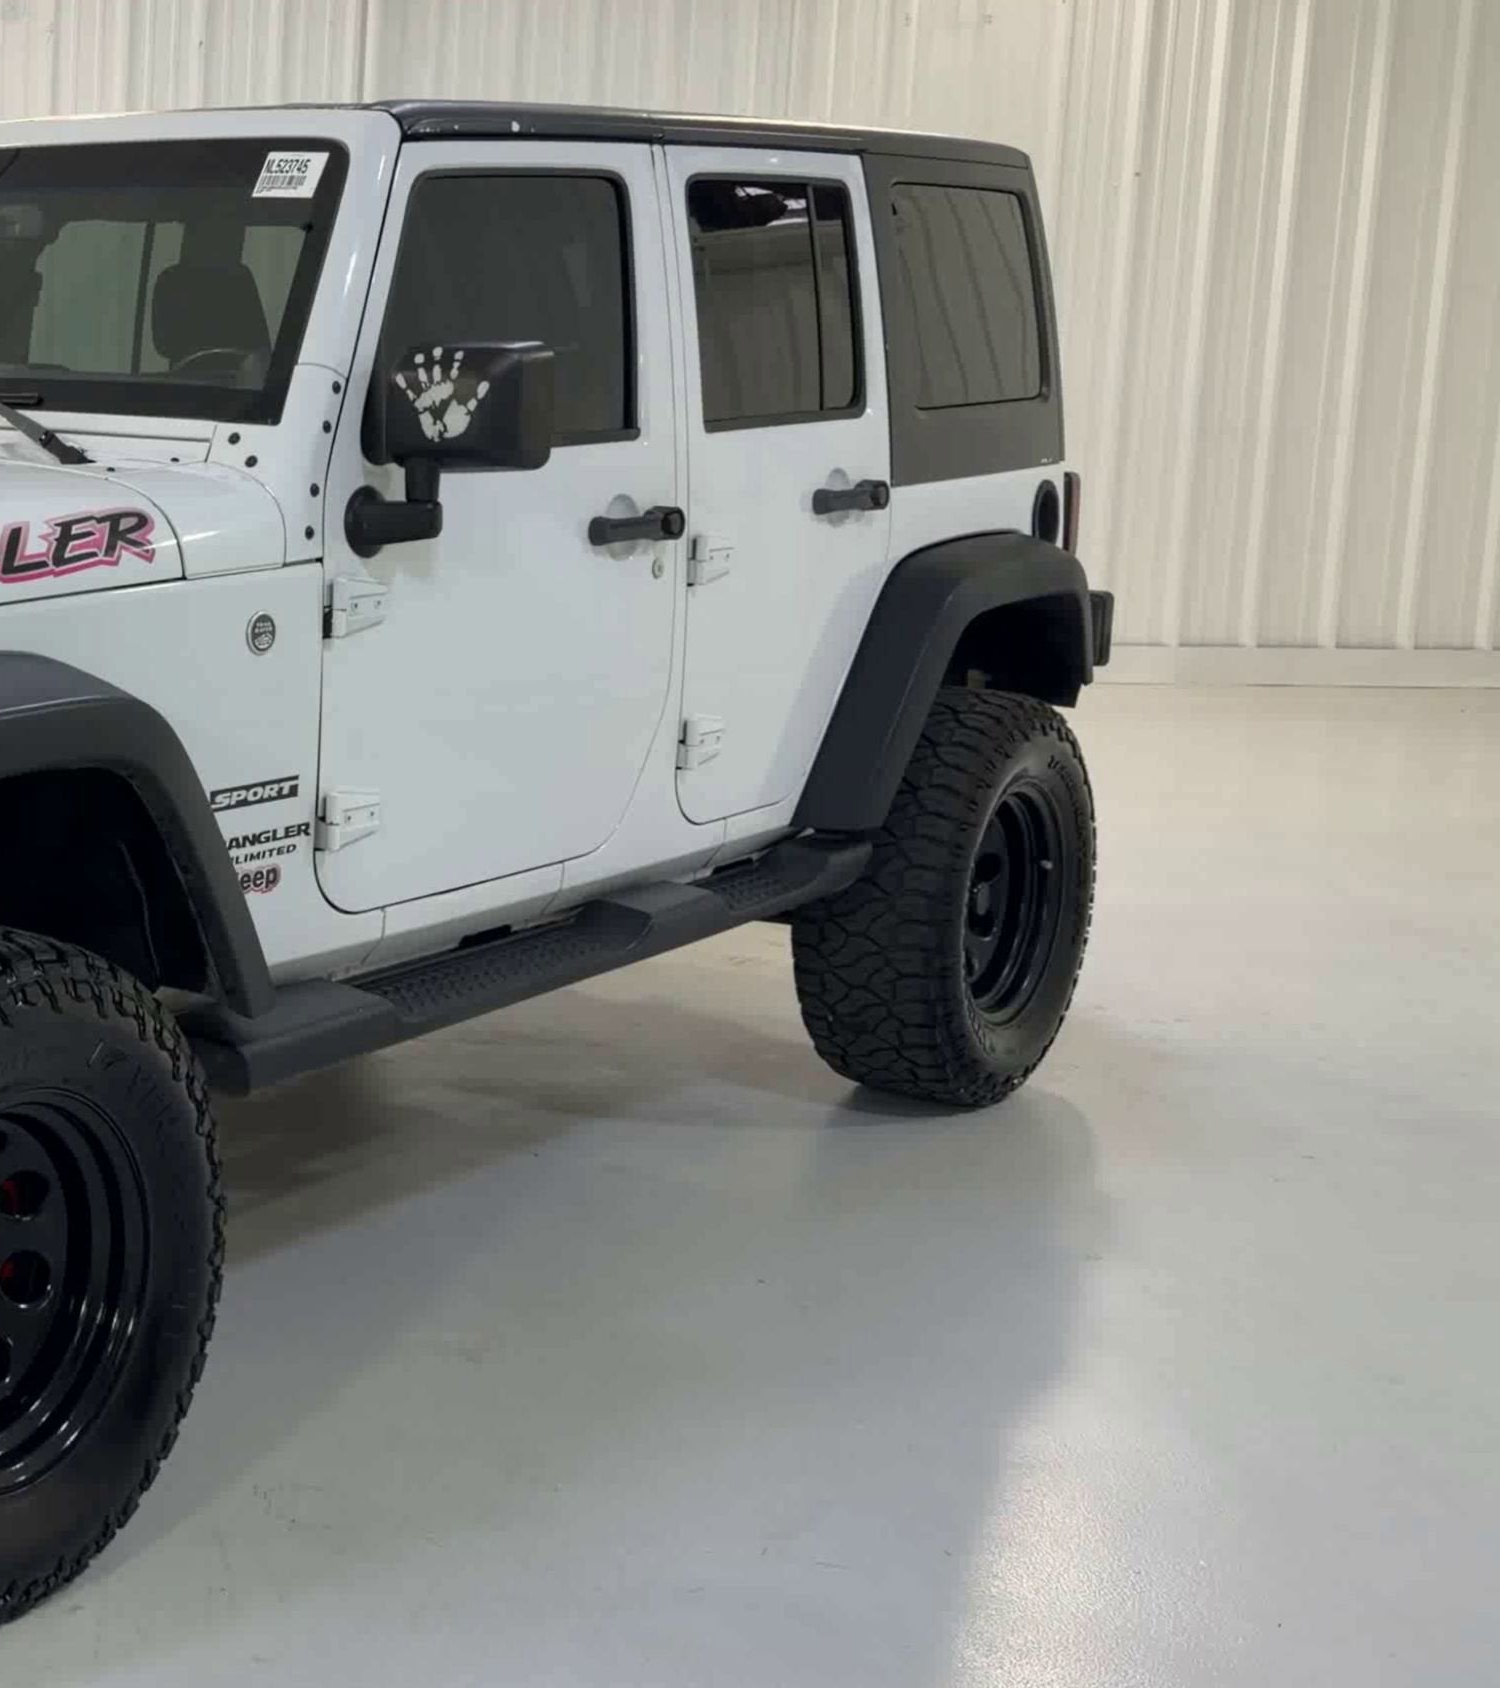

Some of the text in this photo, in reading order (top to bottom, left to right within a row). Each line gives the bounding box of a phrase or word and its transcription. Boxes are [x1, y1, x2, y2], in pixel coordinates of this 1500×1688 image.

[211, 782, 298, 809] SPORT
[226, 821, 312, 850] ANGLER
[239, 865, 278, 892] eep
